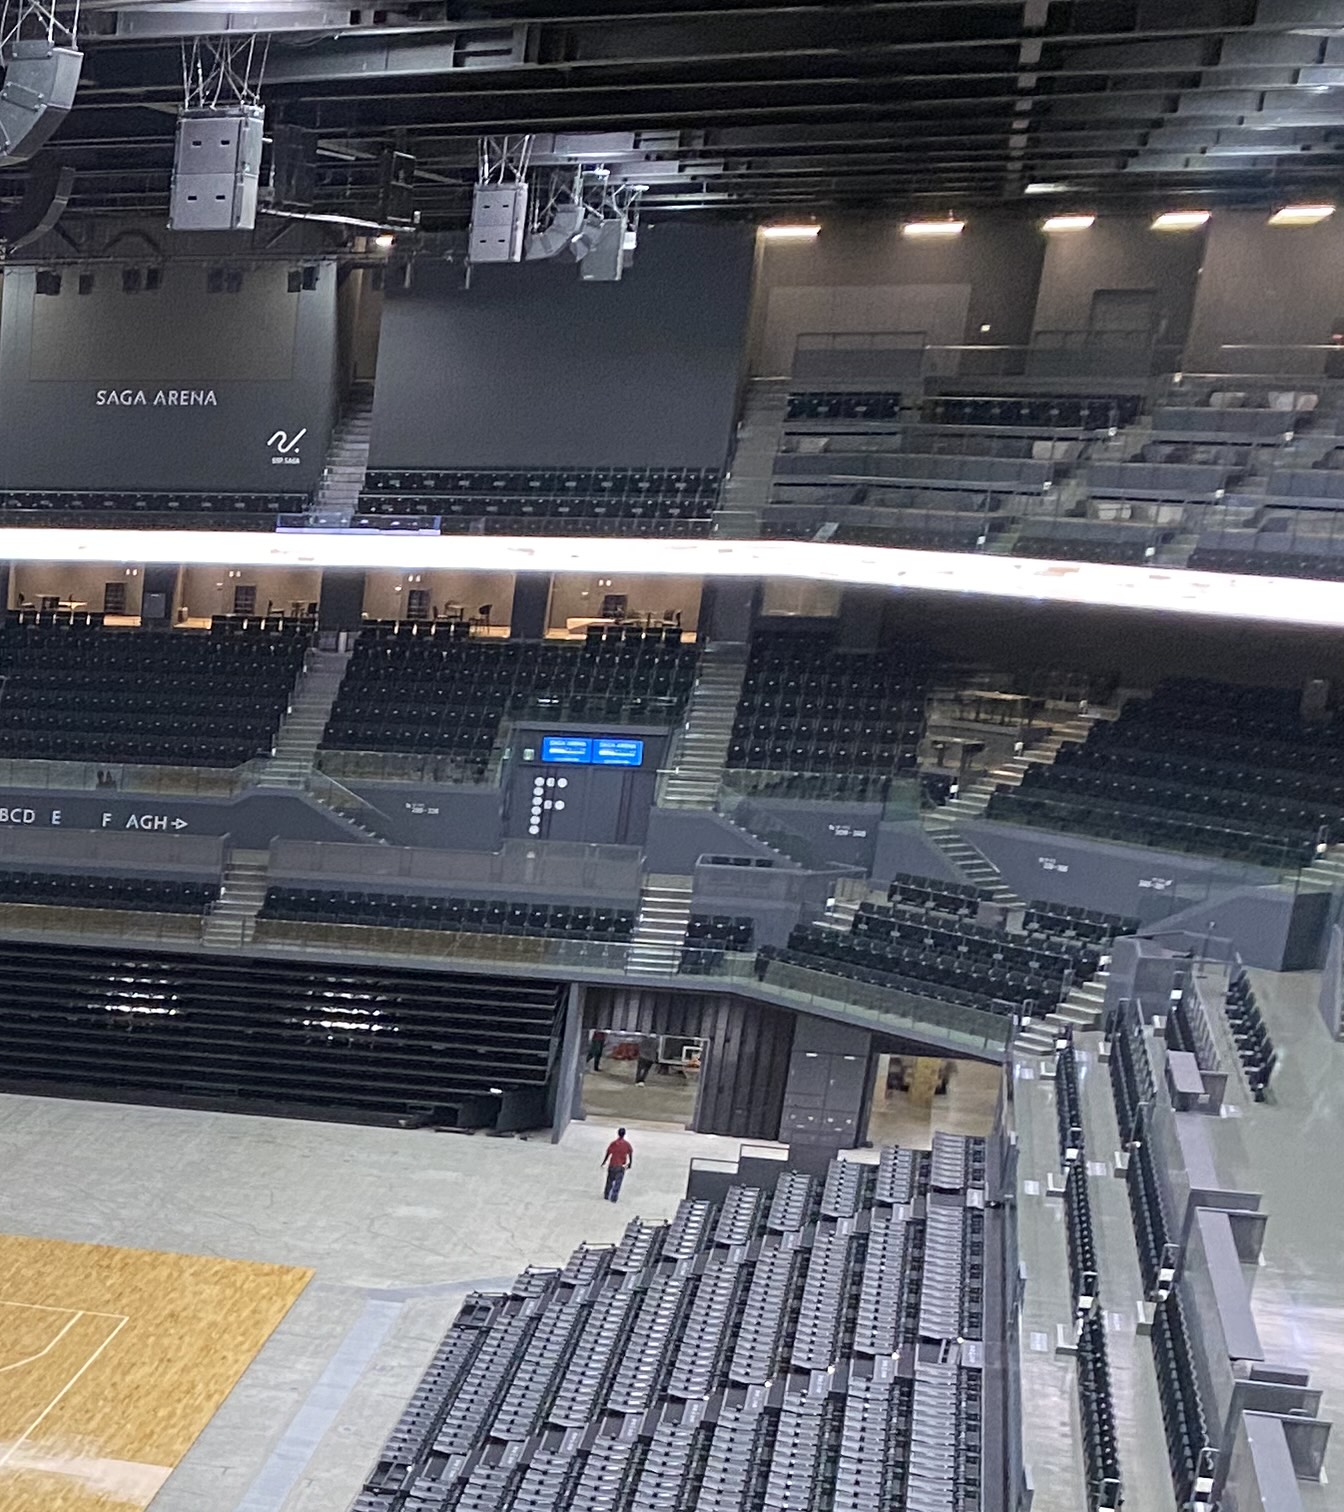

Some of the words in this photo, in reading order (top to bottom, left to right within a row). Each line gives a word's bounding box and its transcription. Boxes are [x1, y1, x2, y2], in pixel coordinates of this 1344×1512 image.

[96, 389, 147, 406] SAGA
[153, 389, 217, 406] ARENA
[51, 810, 62, 825] E
[102, 812, 112, 827] F
[126, 814, 167, 831] AGH
